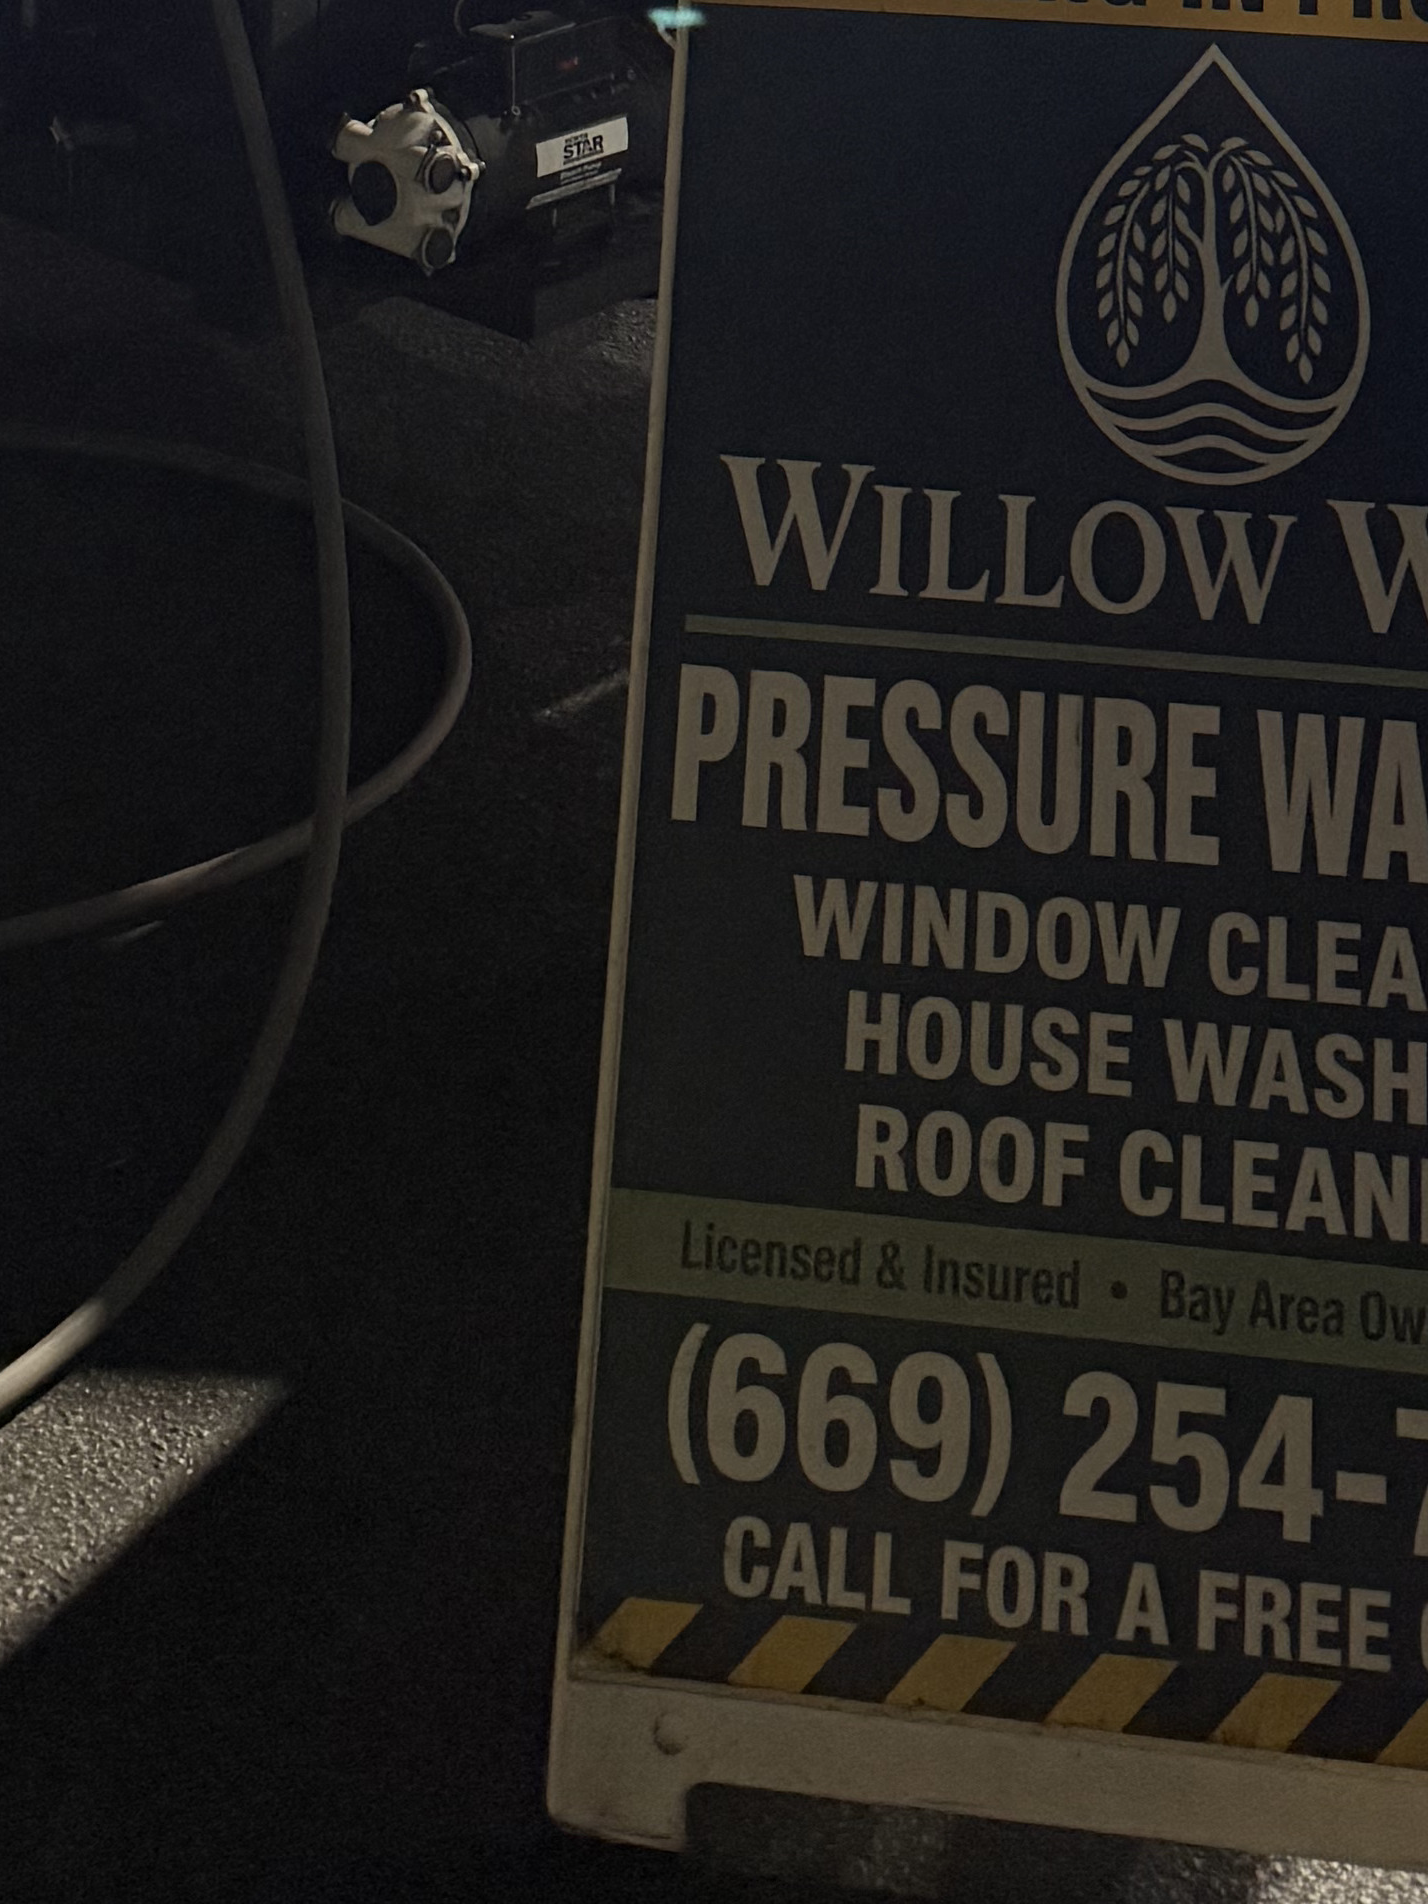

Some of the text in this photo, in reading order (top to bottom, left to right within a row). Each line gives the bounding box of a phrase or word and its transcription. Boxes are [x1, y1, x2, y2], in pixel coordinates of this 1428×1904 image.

[563, 134, 605, 160] STAR
[720, 454, 1298, 626] WILLOW
[671, 663, 1221, 866] PRESSURE
[793, 873, 1182, 990] WINDOW
[845, 989, 1135, 1099] HOUSE
[855, 1103, 1089, 1209] ROOF
[679, 1218, 863, 1291] Licensed
[875, 1237, 907, 1291] &
[922, 1241, 1081, 1310] Insured
[1158, 1269, 1243, 1341] Bay
[1250, 1278, 1345, 1338] Area
[668, 1322, 1014, 1520] (669)
[722, 1514, 913, 1617] CALL
[941, 1540, 1090, 1637] FOR
[1116, 1561, 1170, 1646] A
[1196, 1565, 1393, 1671] FREE
